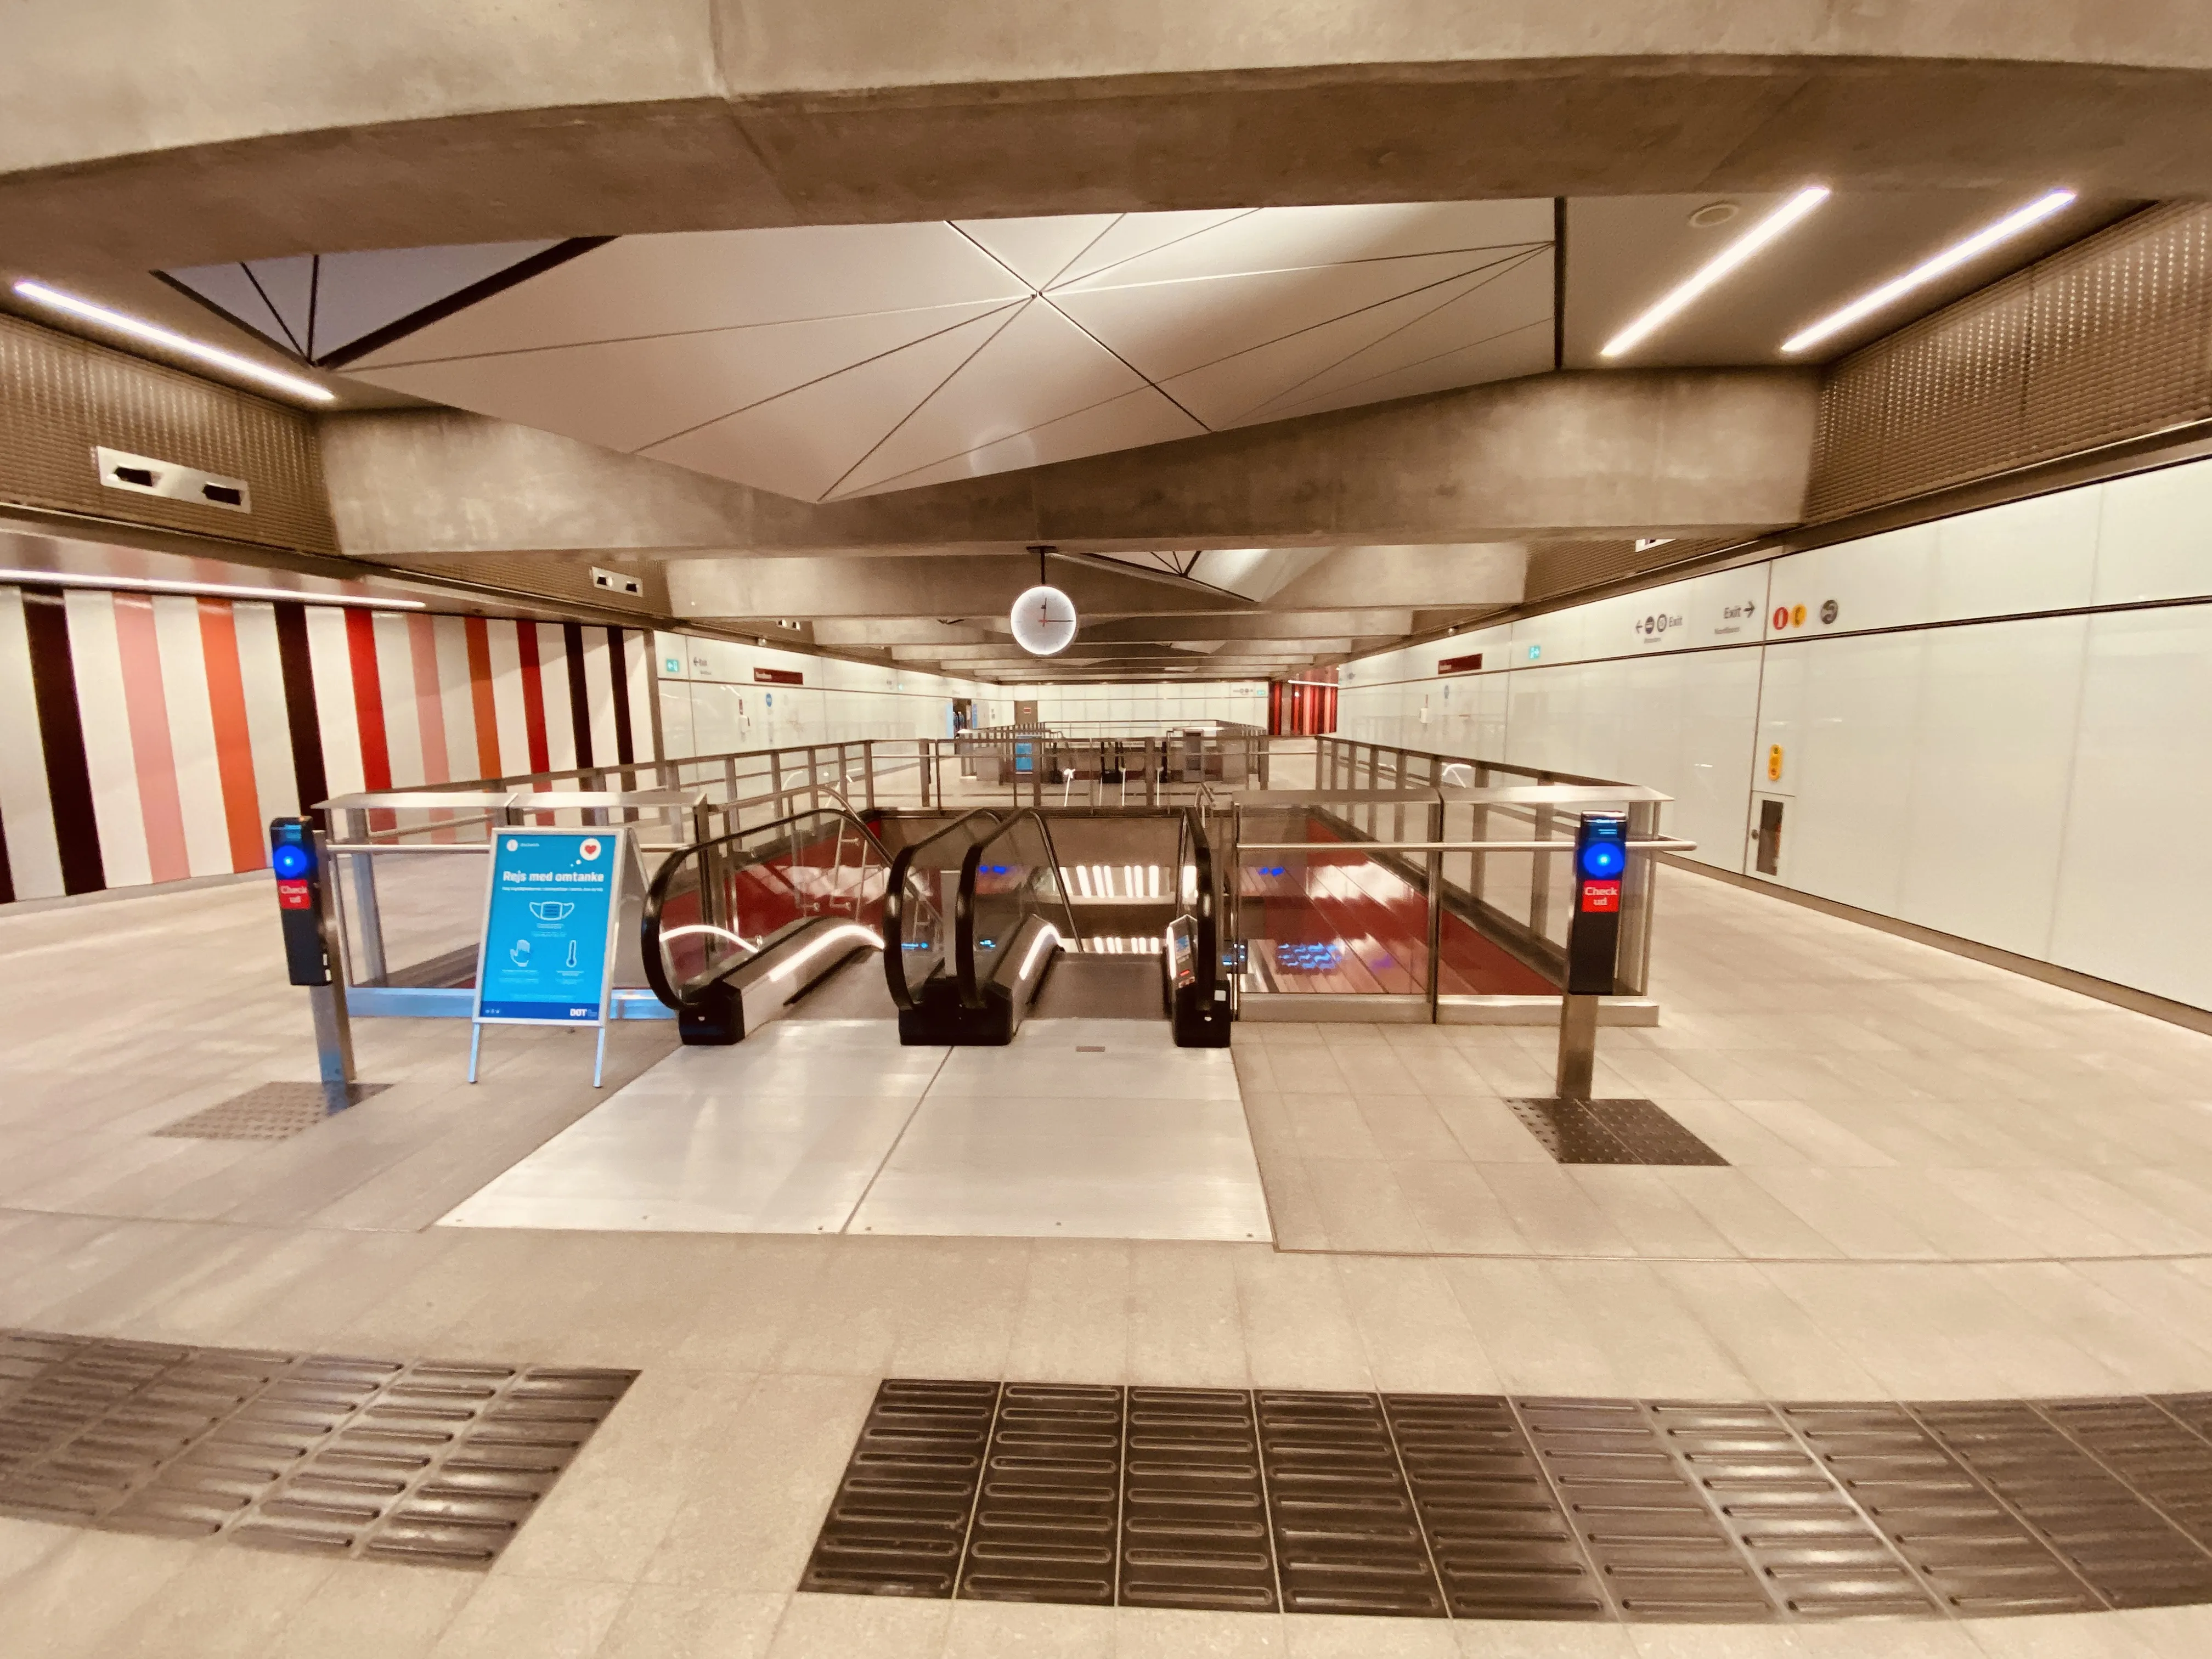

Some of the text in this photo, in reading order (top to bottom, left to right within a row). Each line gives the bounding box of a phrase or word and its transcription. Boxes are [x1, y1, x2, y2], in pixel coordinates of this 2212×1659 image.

[1724, 606, 1741, 619] Exit
[503, 870, 605, 883] Rejs med omtanke
[1584, 887, 1617, 895] Check
[569, 1008, 588, 1017] DOT
